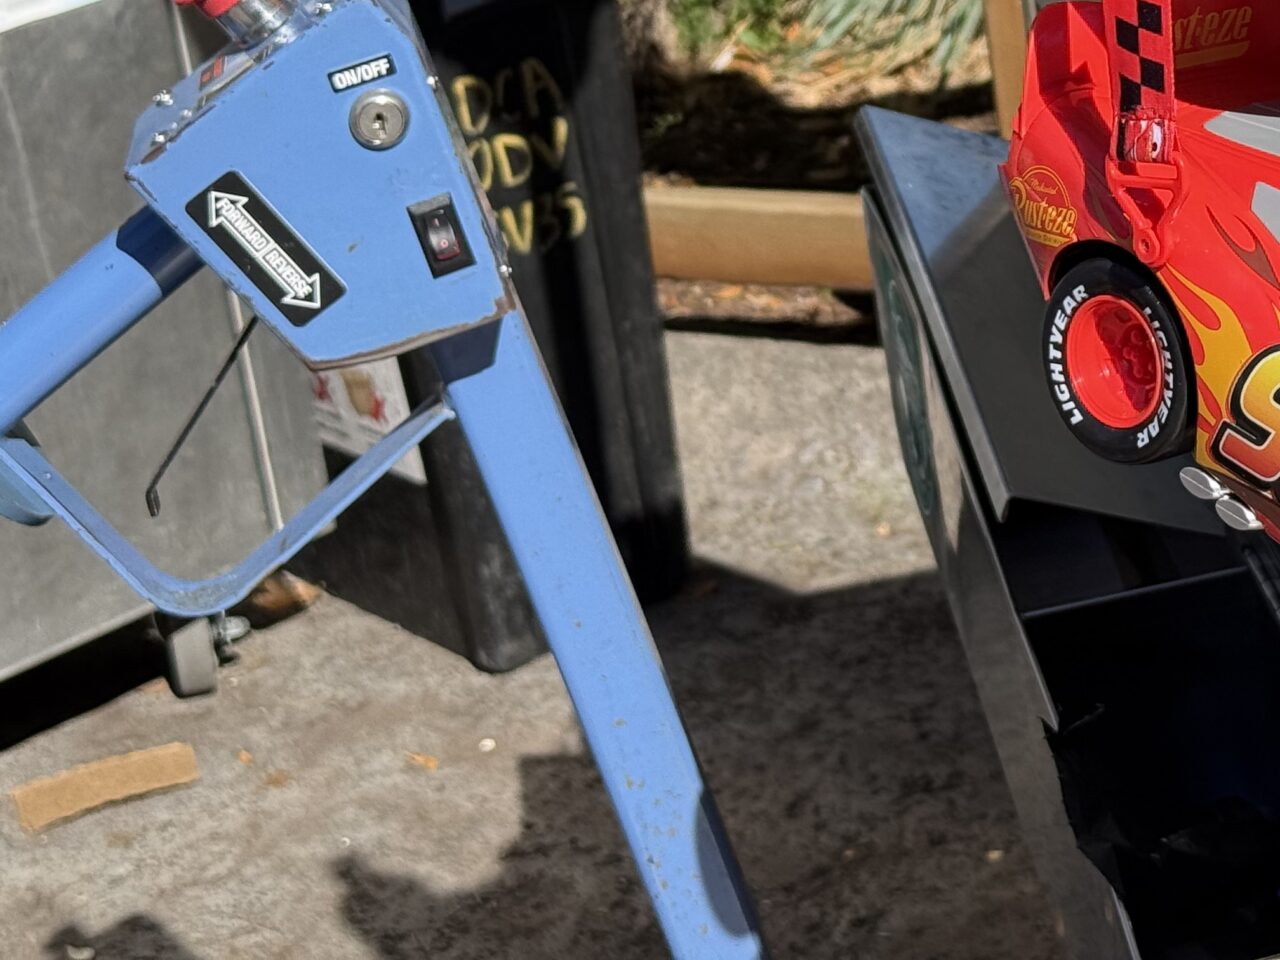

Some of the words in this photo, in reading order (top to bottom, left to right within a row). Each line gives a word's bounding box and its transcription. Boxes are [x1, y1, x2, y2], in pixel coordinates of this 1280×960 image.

[331, 57, 391, 91] ON/OFF
[215, 197, 265, 251] FORWARD
[265, 248, 313, 300] REVERSE
[1048, 284, 1090, 426] LIGHTYEAR
[1136, 306, 1174, 450] LIGHTYEAR
